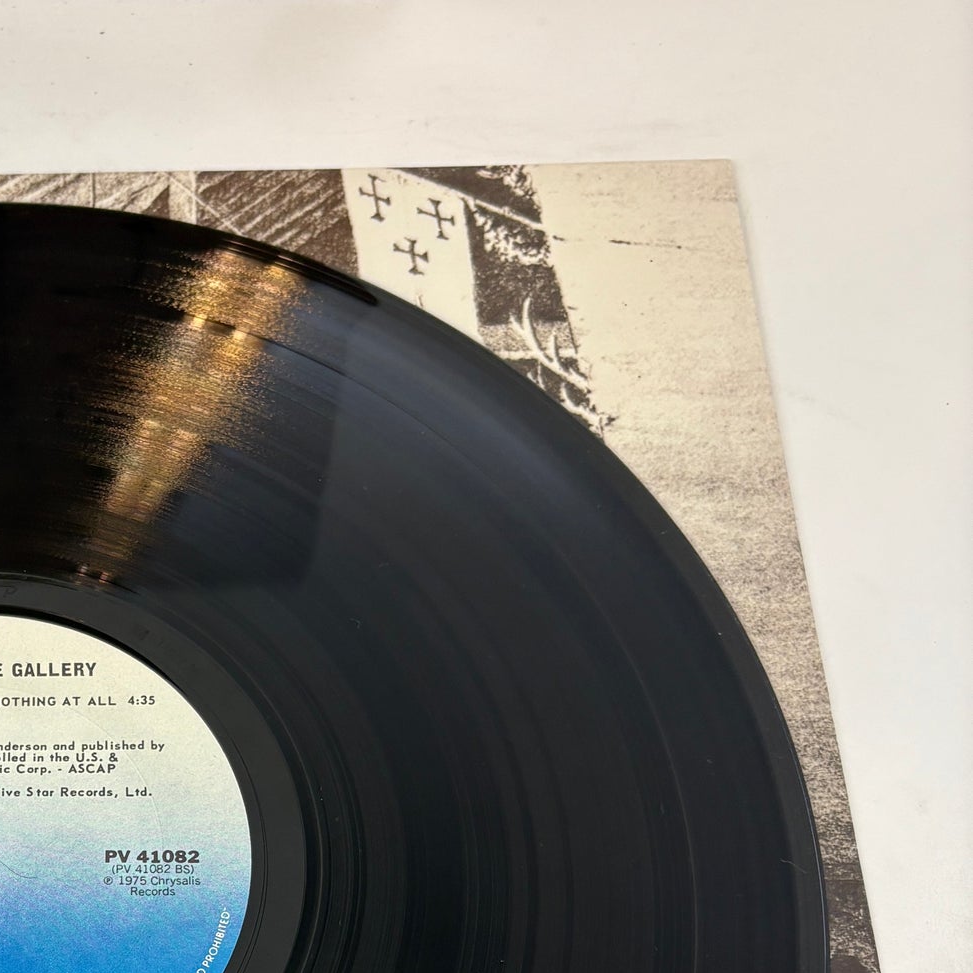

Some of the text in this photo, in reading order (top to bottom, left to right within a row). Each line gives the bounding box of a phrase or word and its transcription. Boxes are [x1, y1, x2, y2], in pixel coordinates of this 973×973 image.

[12, 662, 96, 677] GALLERY
[62, 697, 80, 706] AT
[88, 696, 116, 705] ALL
[128, 696, 155, 705] 4:35
[53, 741, 75, 750] and
[82, 740, 144, 752] published
[151, 741, 165, 752] by
[33, 753, 44, 762] in
[50, 753, 70, 762] the
[76, 753, 103, 762] U.S.
[109, 753, 118, 762] &
[17, 764, 52, 775] Corp.
[68, 764, 116, 773] ASCAP
[27, 787, 54, 796] Star
[60, 787, 118, 798] Records,
[125, 786, 152, 796] Ltd.
[105, 850, 199, 863] PV 41082
[112, 864, 194, 874] (PV 41082 BS)
[119, 876, 147, 885] 1975
[151, 876, 201, 887] Chrysalis
[130, 887, 175, 896] Records
